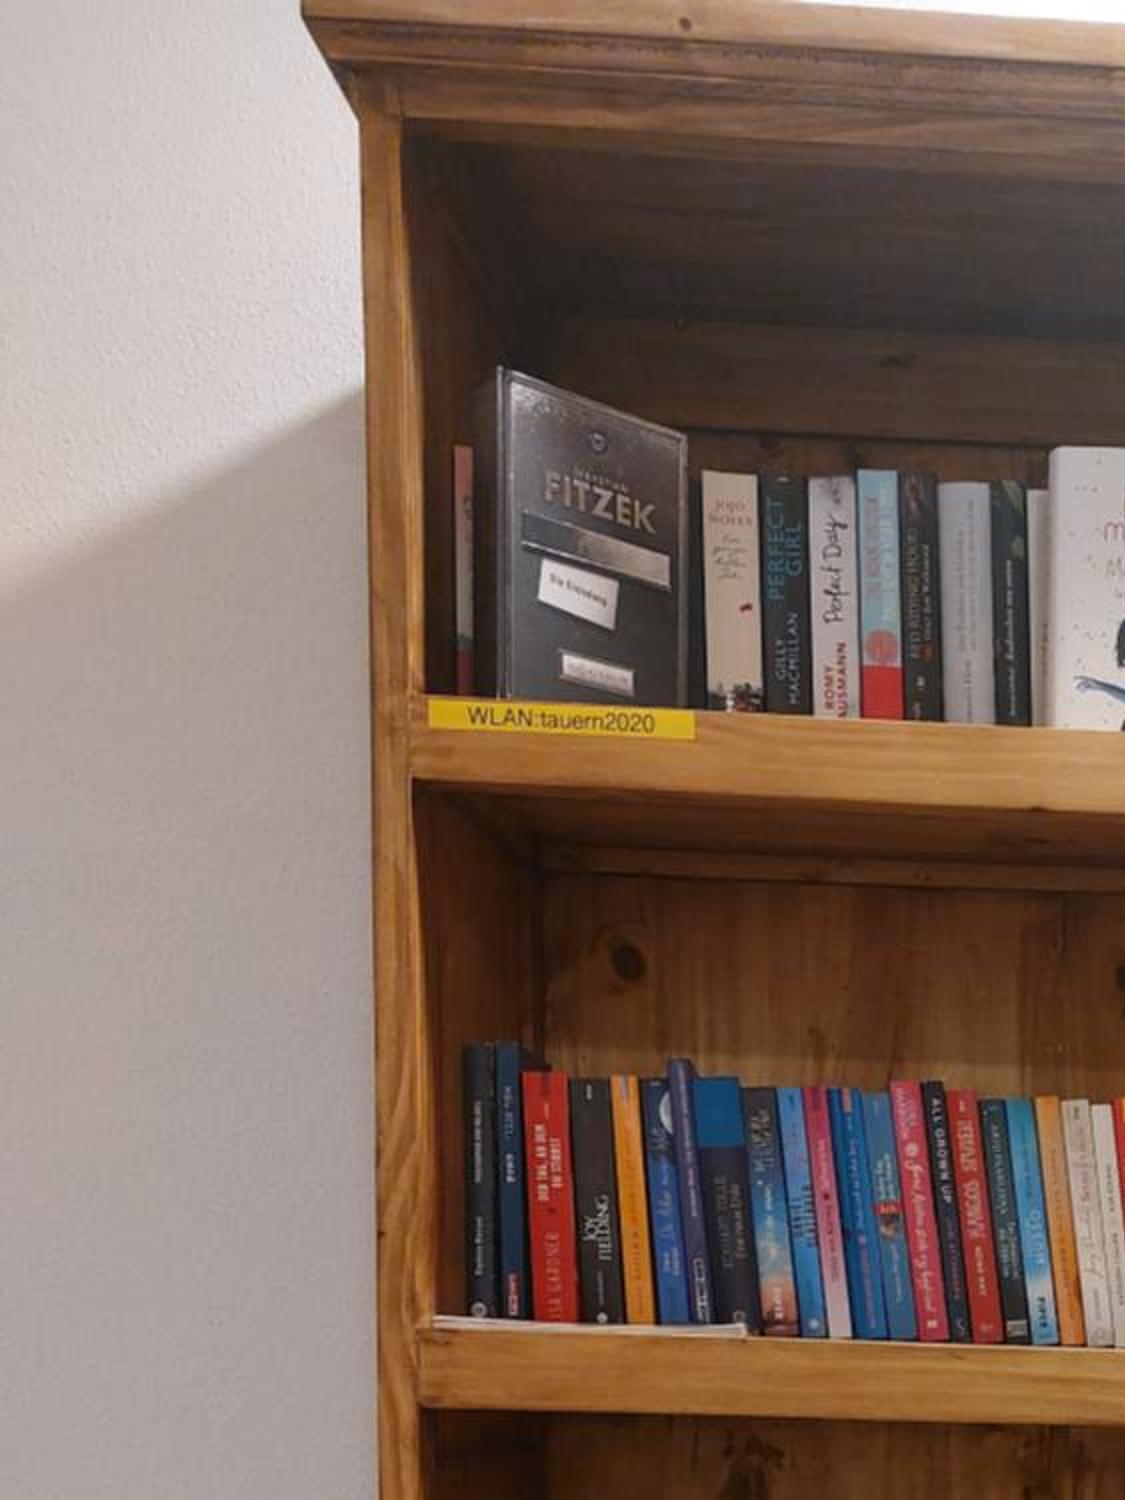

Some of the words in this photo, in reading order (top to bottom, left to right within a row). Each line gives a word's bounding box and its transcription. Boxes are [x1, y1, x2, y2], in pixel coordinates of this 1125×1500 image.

[544, 471, 657, 535] FITZEK
[767, 497, 785, 601] PERFECT
[787, 522, 803, 577] GIRL
[821, 514, 849, 561] Day
[819, 566, 851, 624] Perfect
[787, 612, 801, 705] MACMILLAN
[835, 642, 849, 719] AUSMANN
[467, 706, 656, 734] WLAN:tauern2020
[581, 1215, 598, 1242] JOY
[596, 1193, 613, 1262] FIELDING
